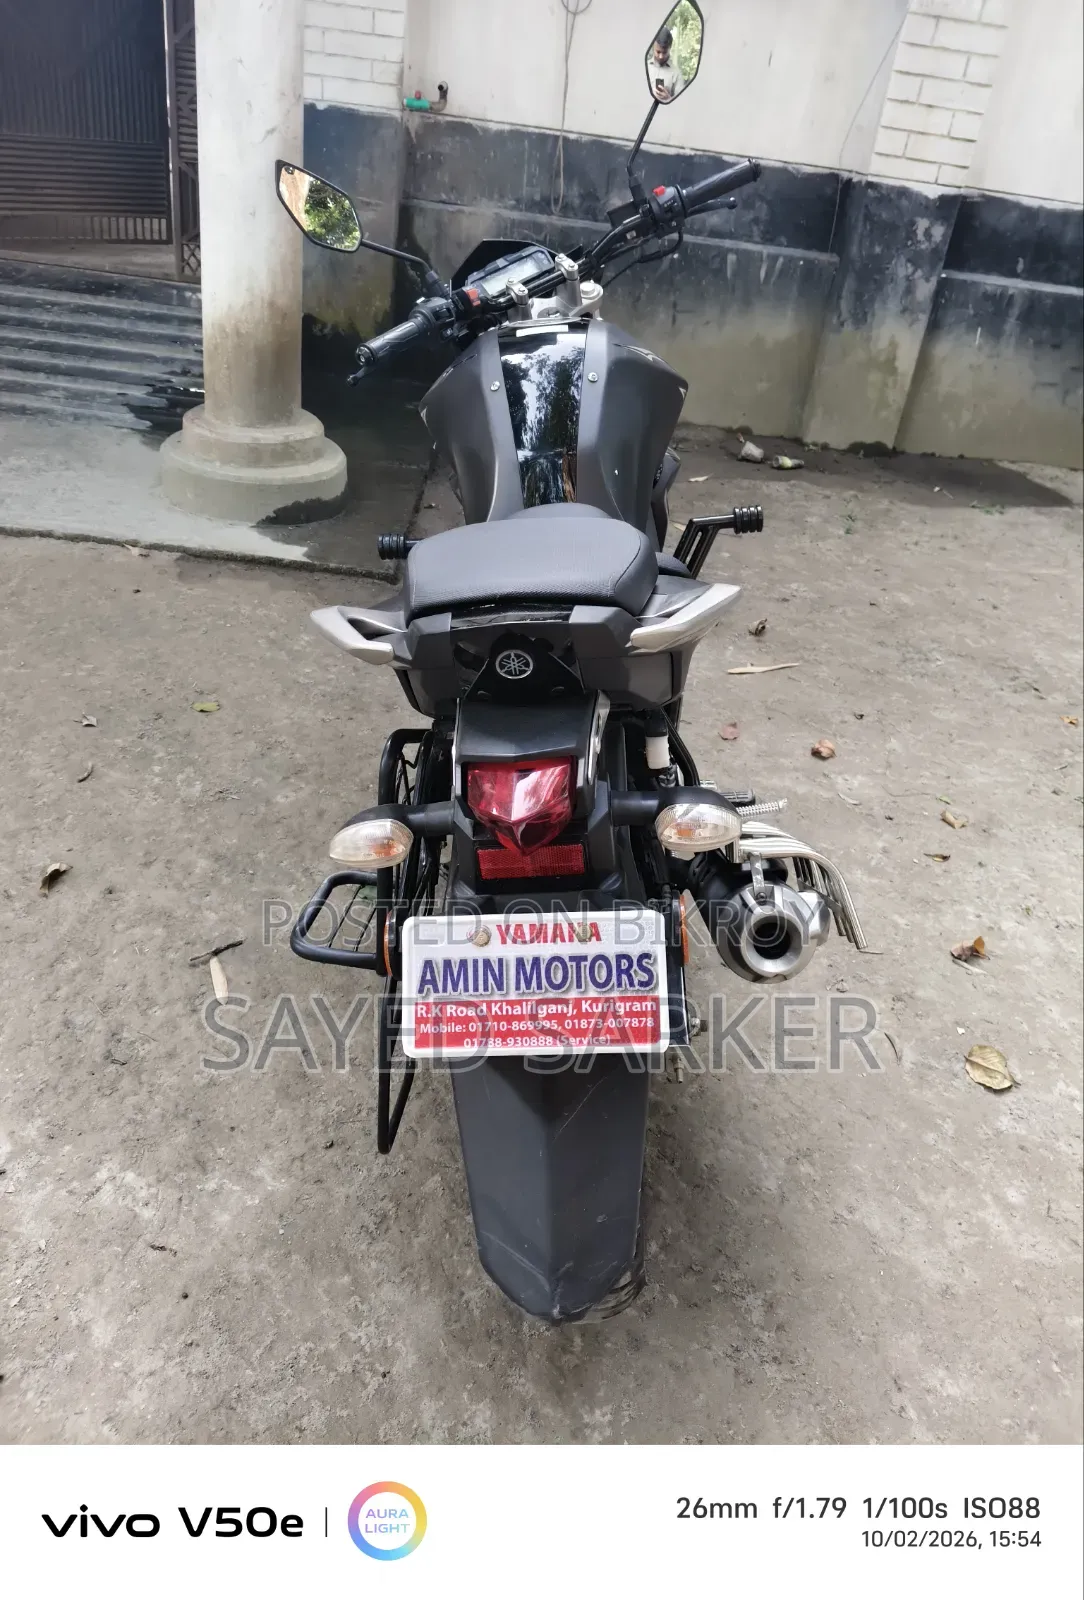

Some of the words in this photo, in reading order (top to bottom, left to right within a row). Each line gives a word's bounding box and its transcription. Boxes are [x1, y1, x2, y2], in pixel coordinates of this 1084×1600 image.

[417, 957, 505, 995] AMIN
[514, 952, 656, 993] MOTORS
[417, 1004, 442, 1018] R.K
[446, 1003, 487, 1017] Road
[491, 1000, 577, 1018] Khalilganj,
[581, 999, 657, 1014] Kurigram
[420, 1022, 466, 1034] Mobile:
[468, 1019, 562, 1032] 01710-869995,
[564, 1017, 655, 1030] 01873-007878
[463, 1036, 553, 1048] 01788-930888
[556, 1034, 611, 1046] (Service)
